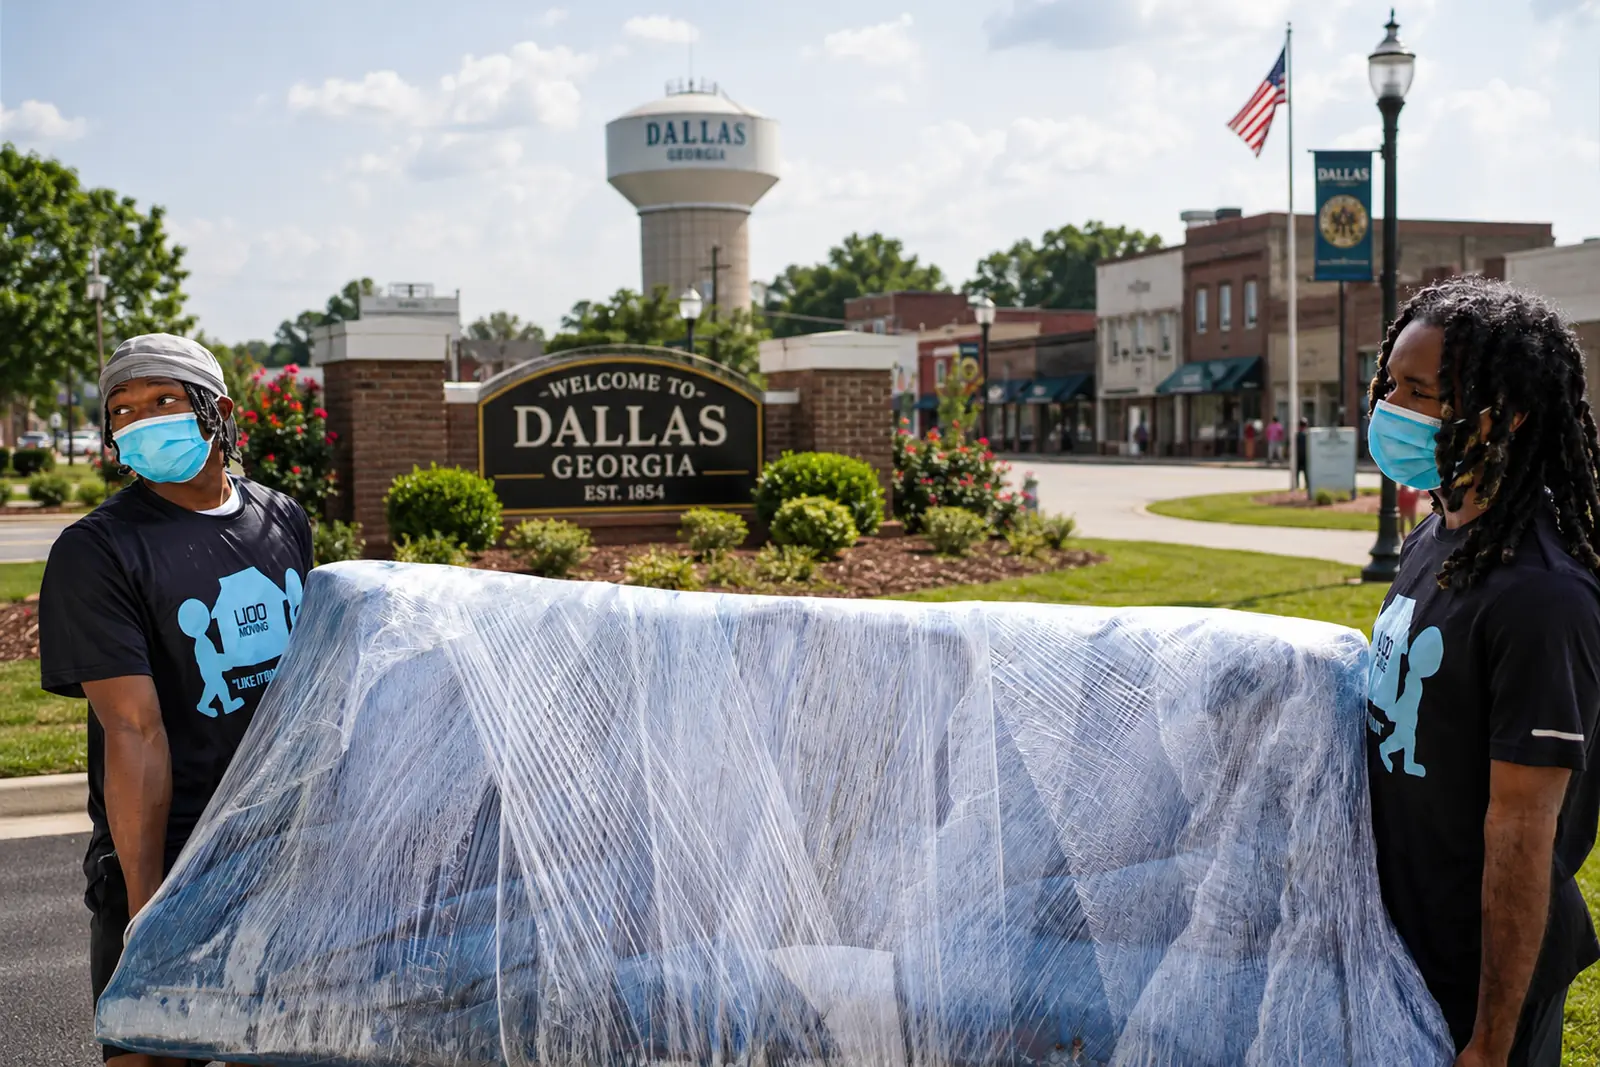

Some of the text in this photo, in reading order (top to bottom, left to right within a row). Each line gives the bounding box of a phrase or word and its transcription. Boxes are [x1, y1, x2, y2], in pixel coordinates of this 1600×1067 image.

[646, 120, 745, 146] DALLAS
[667, 148, 725, 161] GEORGIA
[1318, 168, 1370, 181] DALLAS
[548, 372, 695, 399] WELCOME TO
[513, 405, 727, 447] DALLAS
[551, 454, 696, 479] GEORGIA
[584, 484, 665, 501] EST. 1854
[239, 621, 269, 638] MOVING
